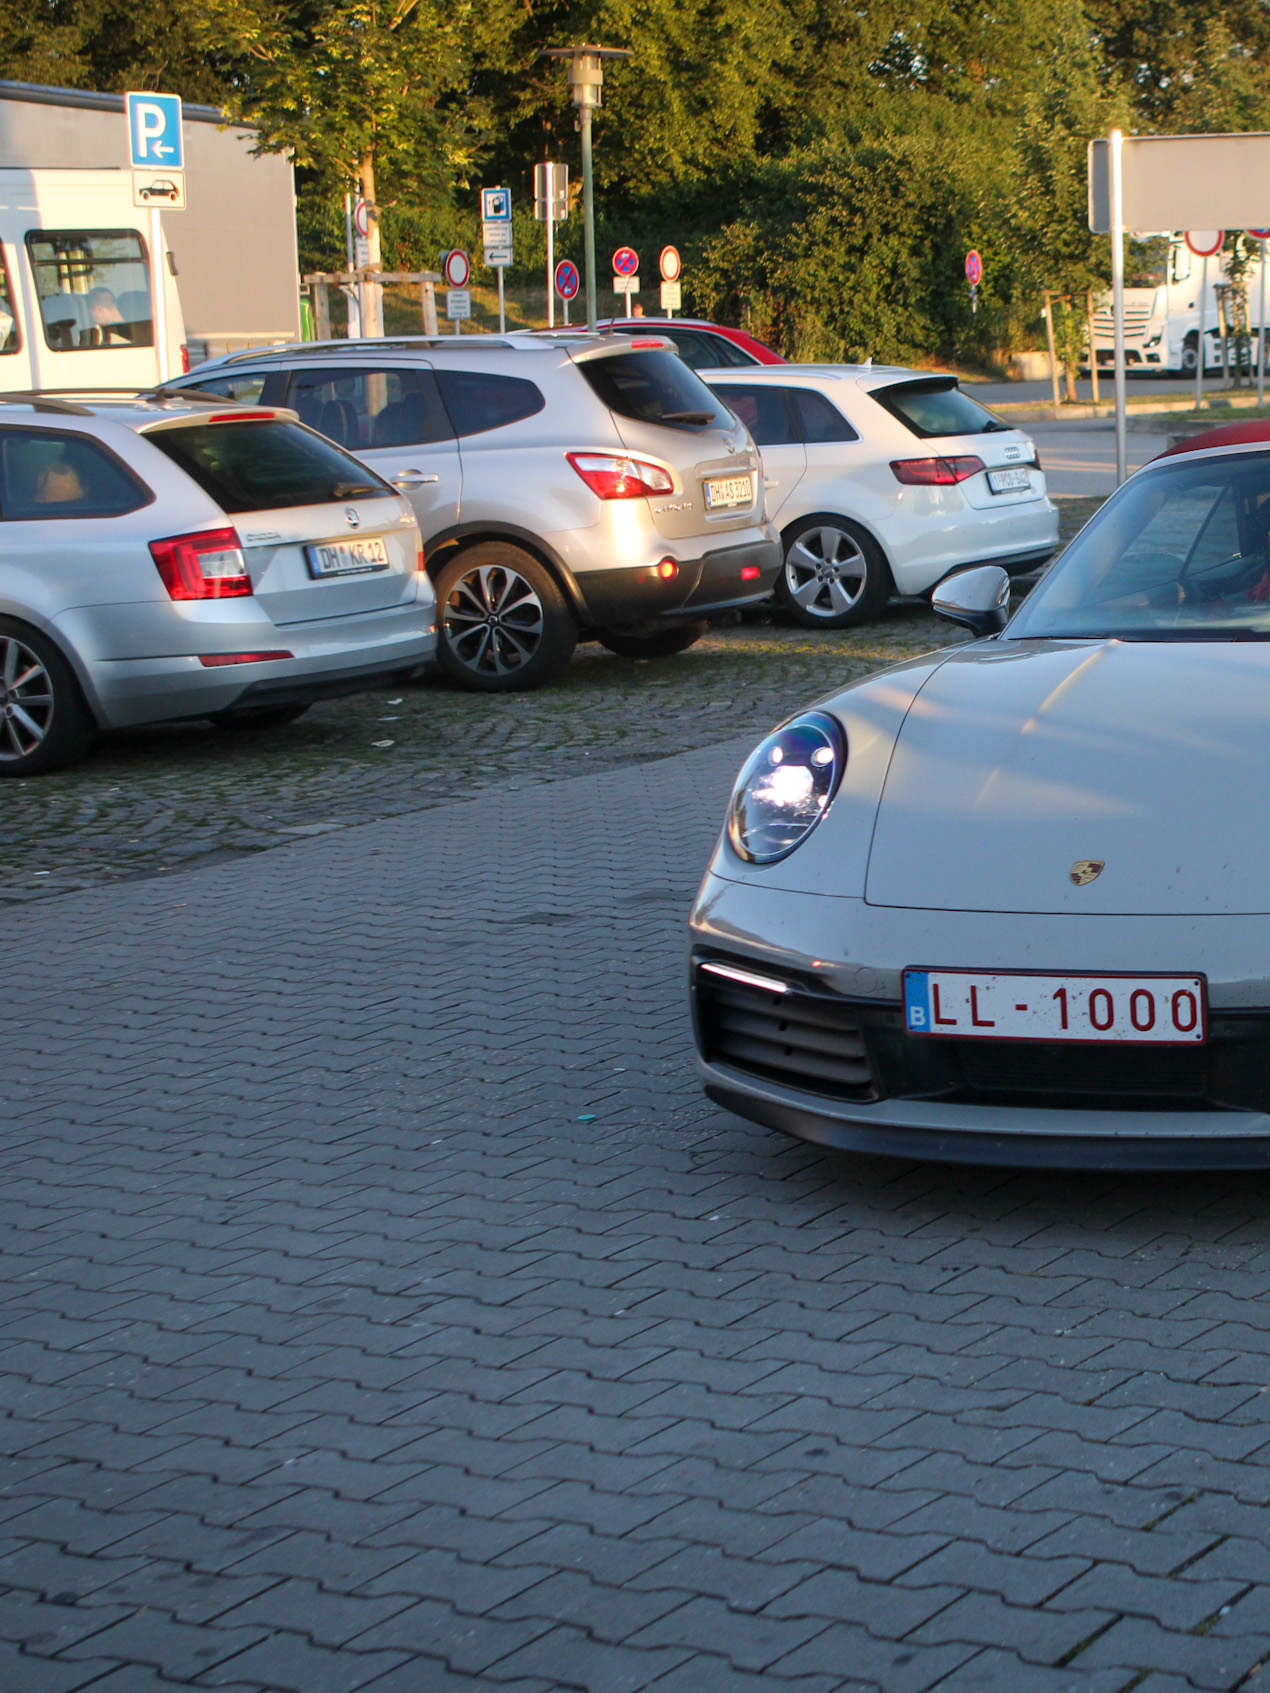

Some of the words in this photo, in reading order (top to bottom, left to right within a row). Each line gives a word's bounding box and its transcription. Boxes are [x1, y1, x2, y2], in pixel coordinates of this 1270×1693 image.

[136, 103, 166, 158] P
[710, 483, 721, 502] DH
[319, 547, 340, 570] DH
[347, 544, 368, 566] KR
[368, 541, 385, 563] 12
[910, 1006, 926, 1026] B
